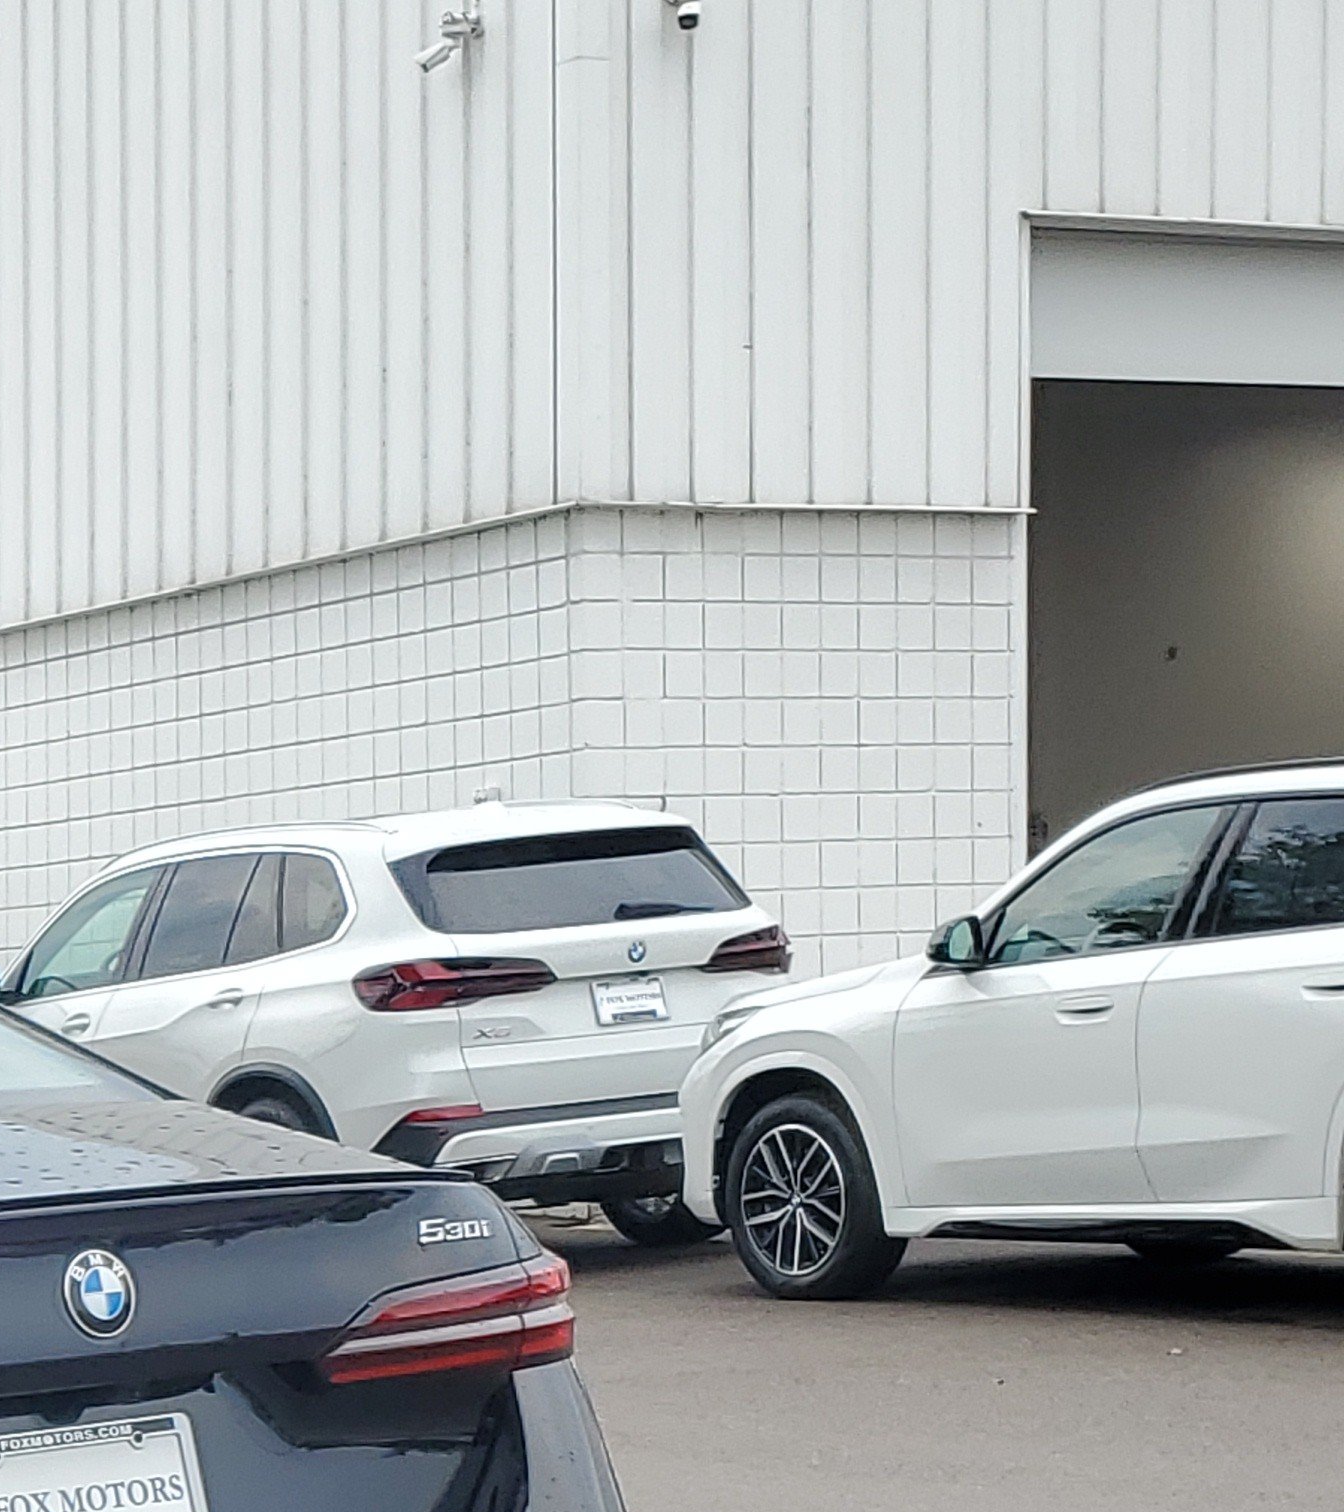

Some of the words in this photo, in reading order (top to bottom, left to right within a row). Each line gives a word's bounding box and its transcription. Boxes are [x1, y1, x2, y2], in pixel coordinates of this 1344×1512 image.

[417, 1216, 492, 1244] 530i
[71, 1253, 126, 1282] BMW
[0, 1424, 134, 1451] FOXMOTORS.COM
